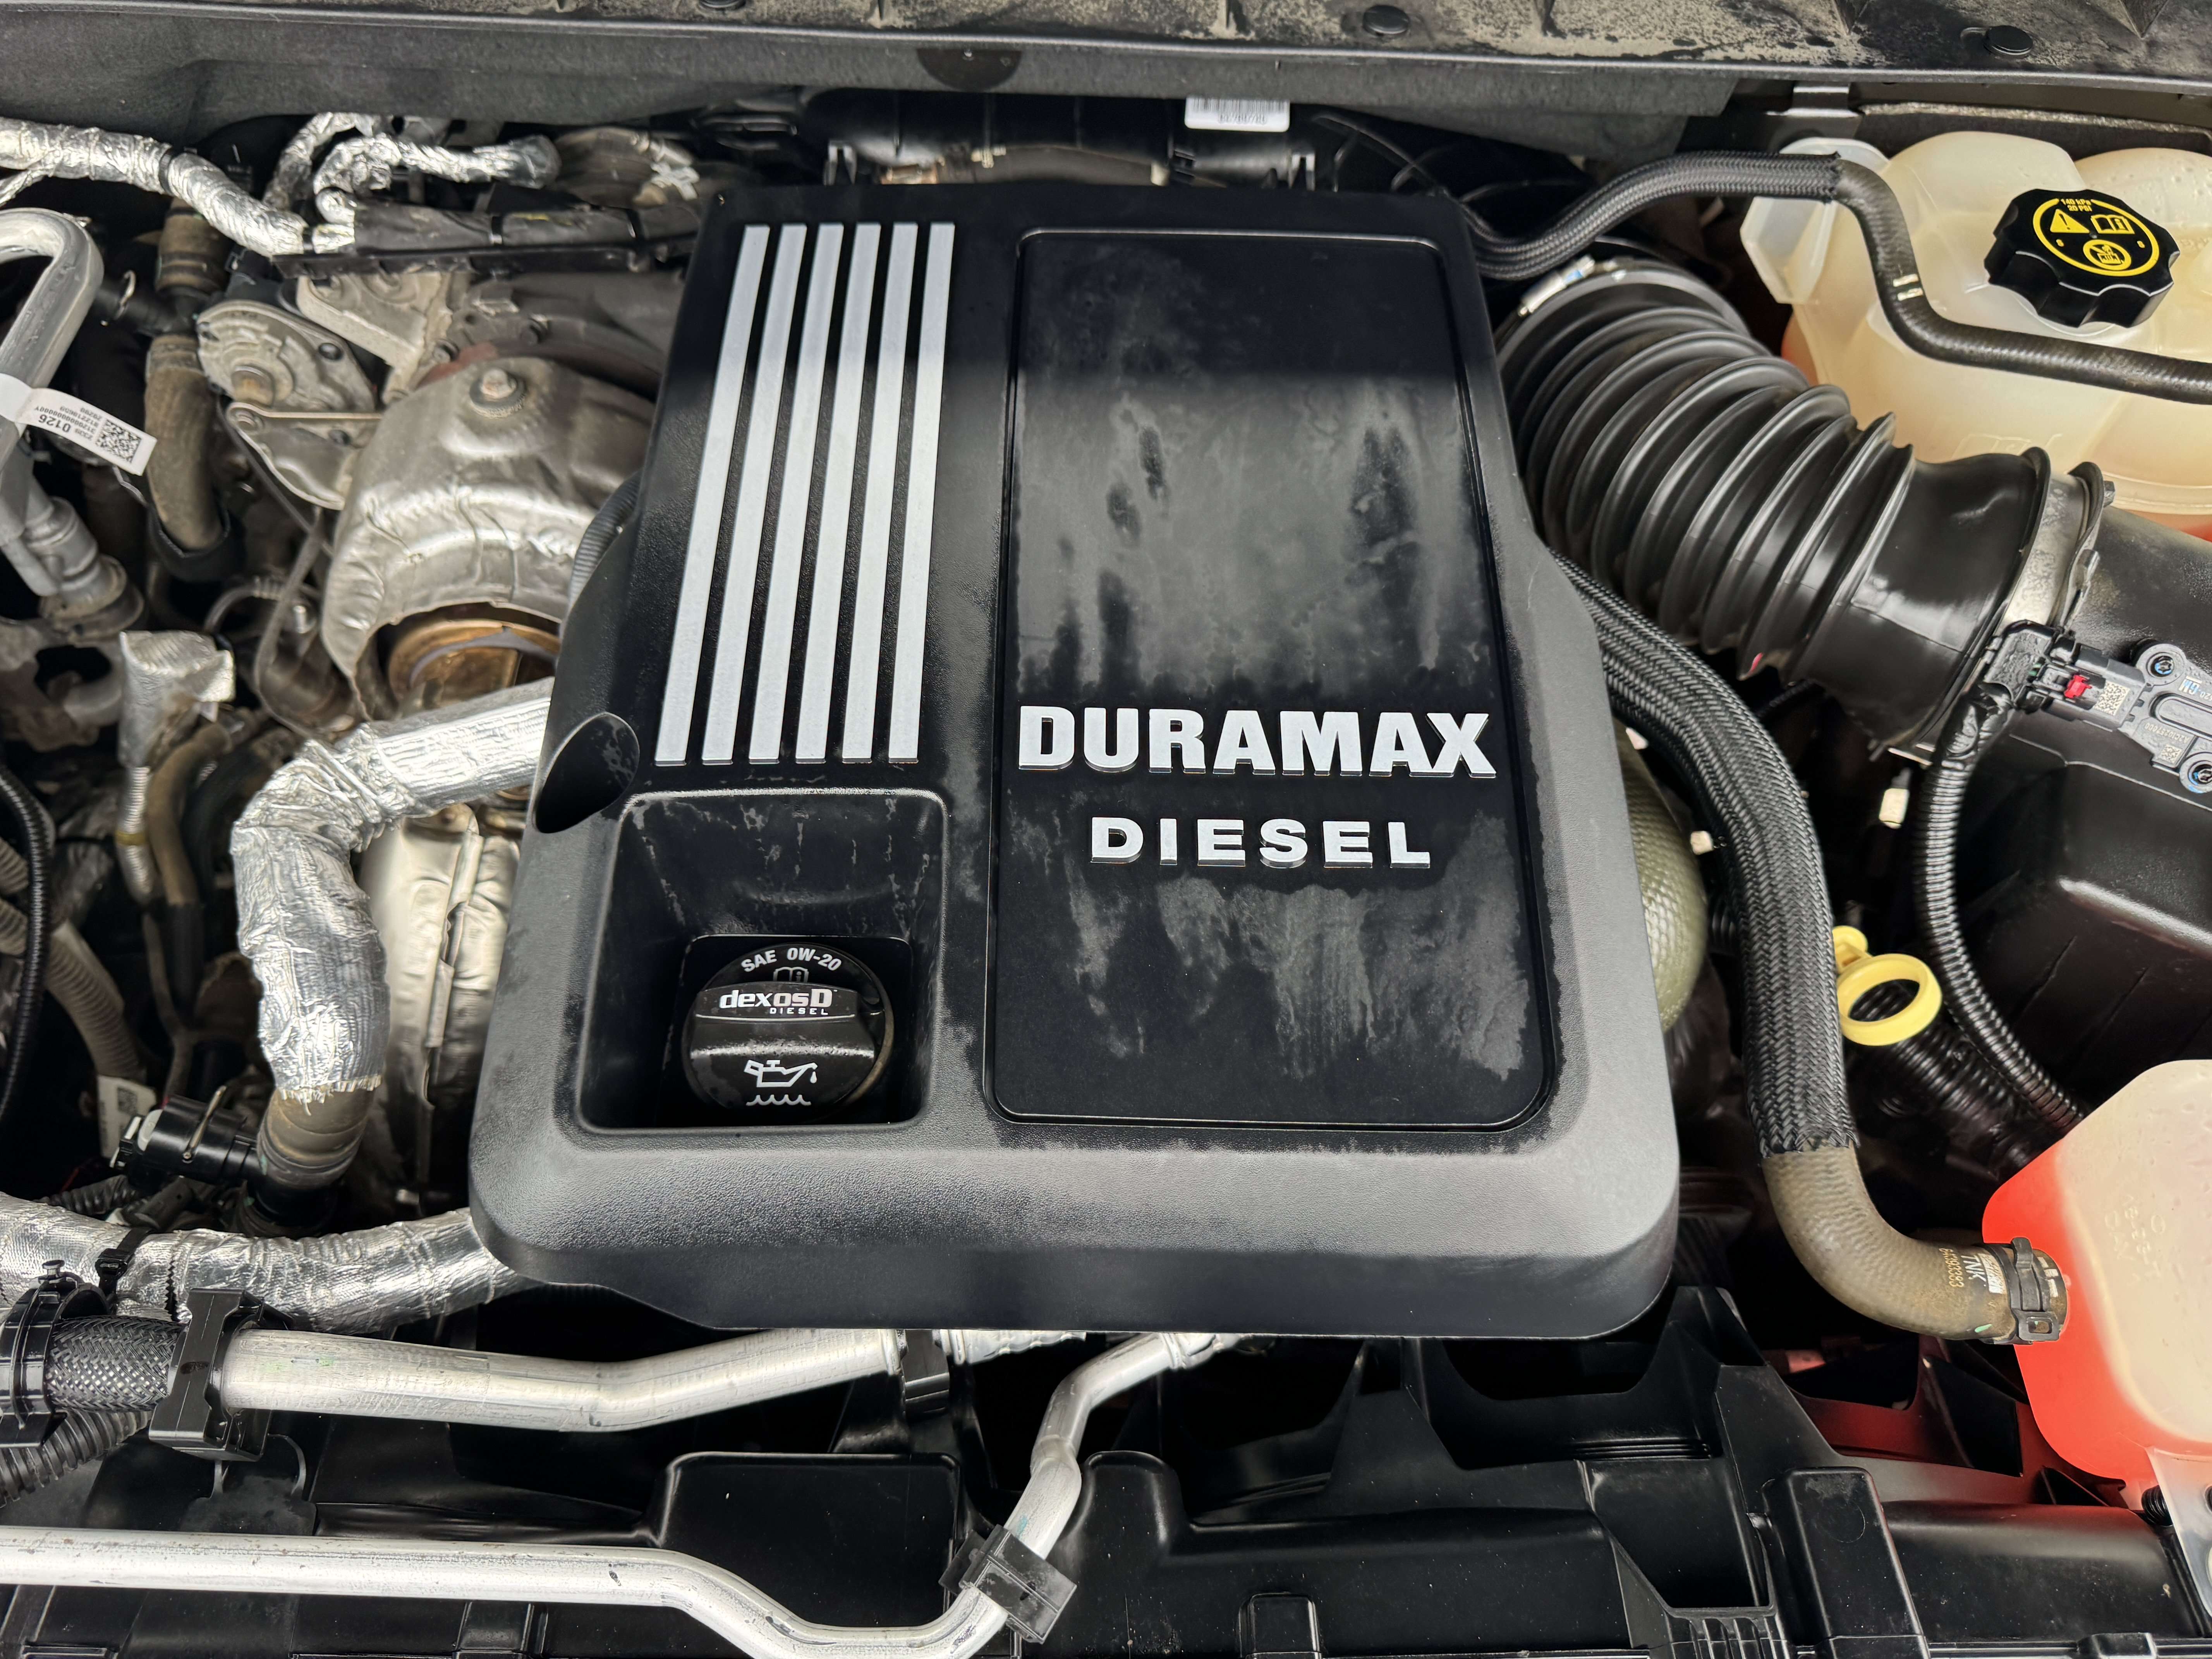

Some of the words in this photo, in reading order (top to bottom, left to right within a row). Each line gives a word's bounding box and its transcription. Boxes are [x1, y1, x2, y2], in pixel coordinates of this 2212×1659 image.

[38, 414, 72, 433] 0126
[1018, 705, 1496, 778] DURAMAX
[1091, 817, 1431, 869] DIESEL
[741, 950, 777, 972] SAE
[787, 947, 842, 971] 0W-20
